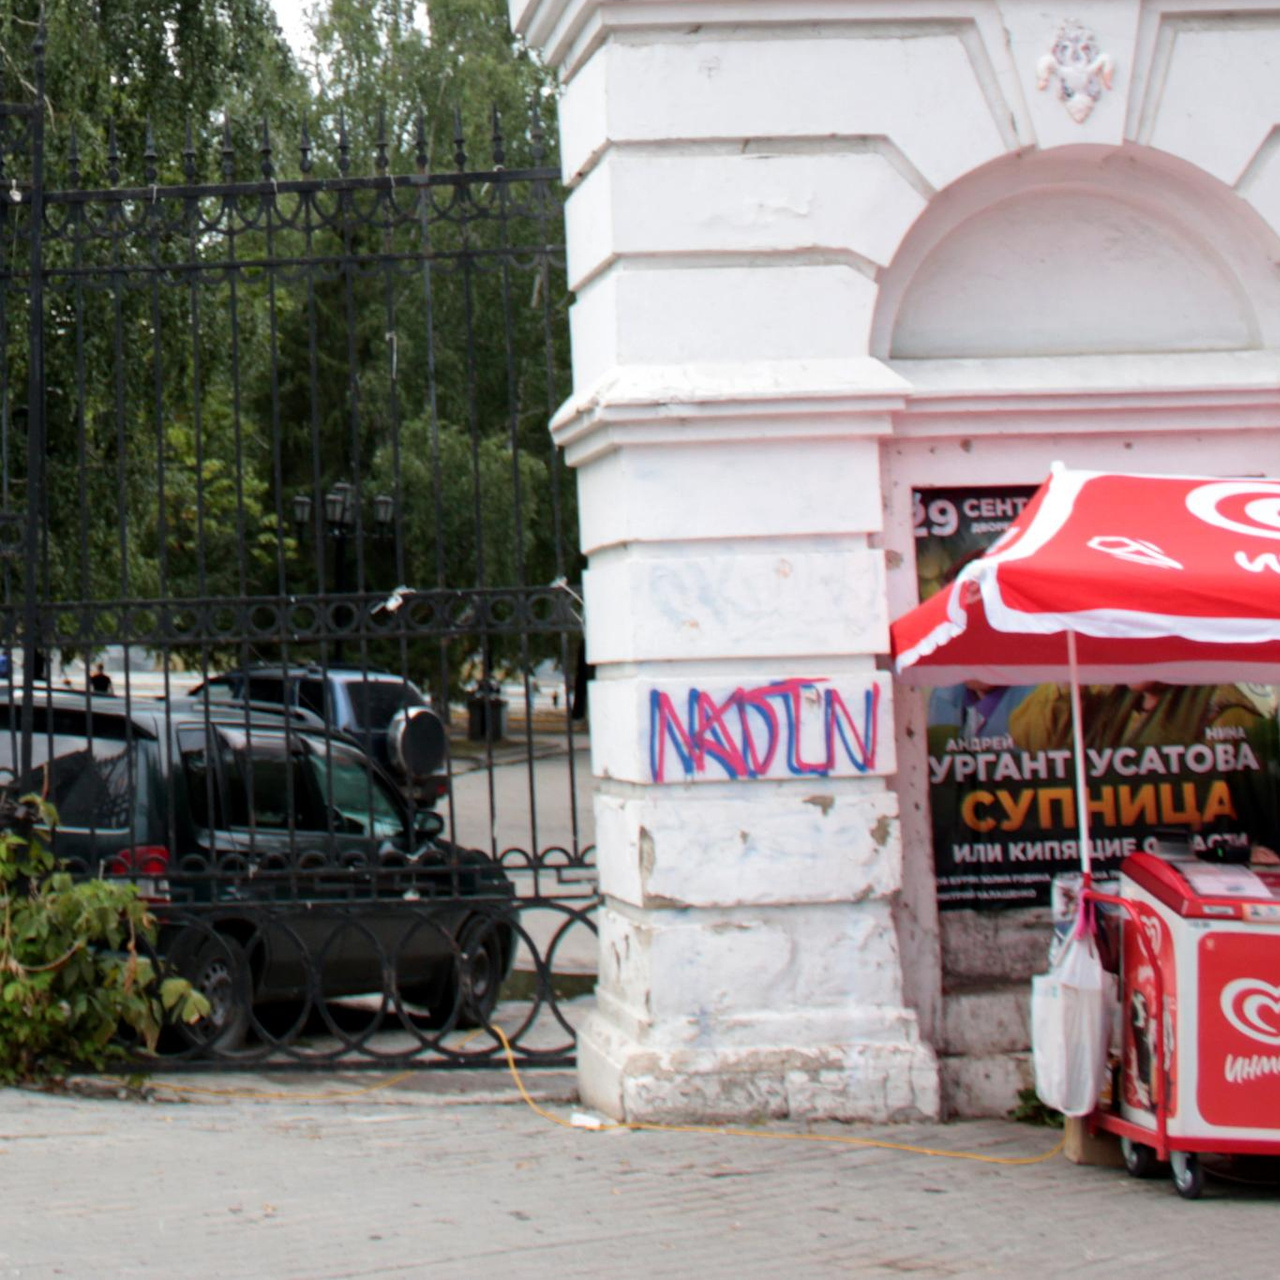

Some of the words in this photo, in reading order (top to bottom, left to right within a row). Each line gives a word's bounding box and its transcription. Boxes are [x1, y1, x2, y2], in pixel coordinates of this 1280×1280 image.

[945, 732, 1015, 752] АНДРЕЙ
[1204, 726, 1246, 741] НИНА
[929, 749, 1072, 784] УРГАНТ
[1086, 742, 1260, 777] УСАТОВА
[961, 779, 1238, 833] СУПНИЦА
[953, 843, 1004, 863] ИЛИ
[1008, 837, 1138, 862] КИПЯЩИЕ
